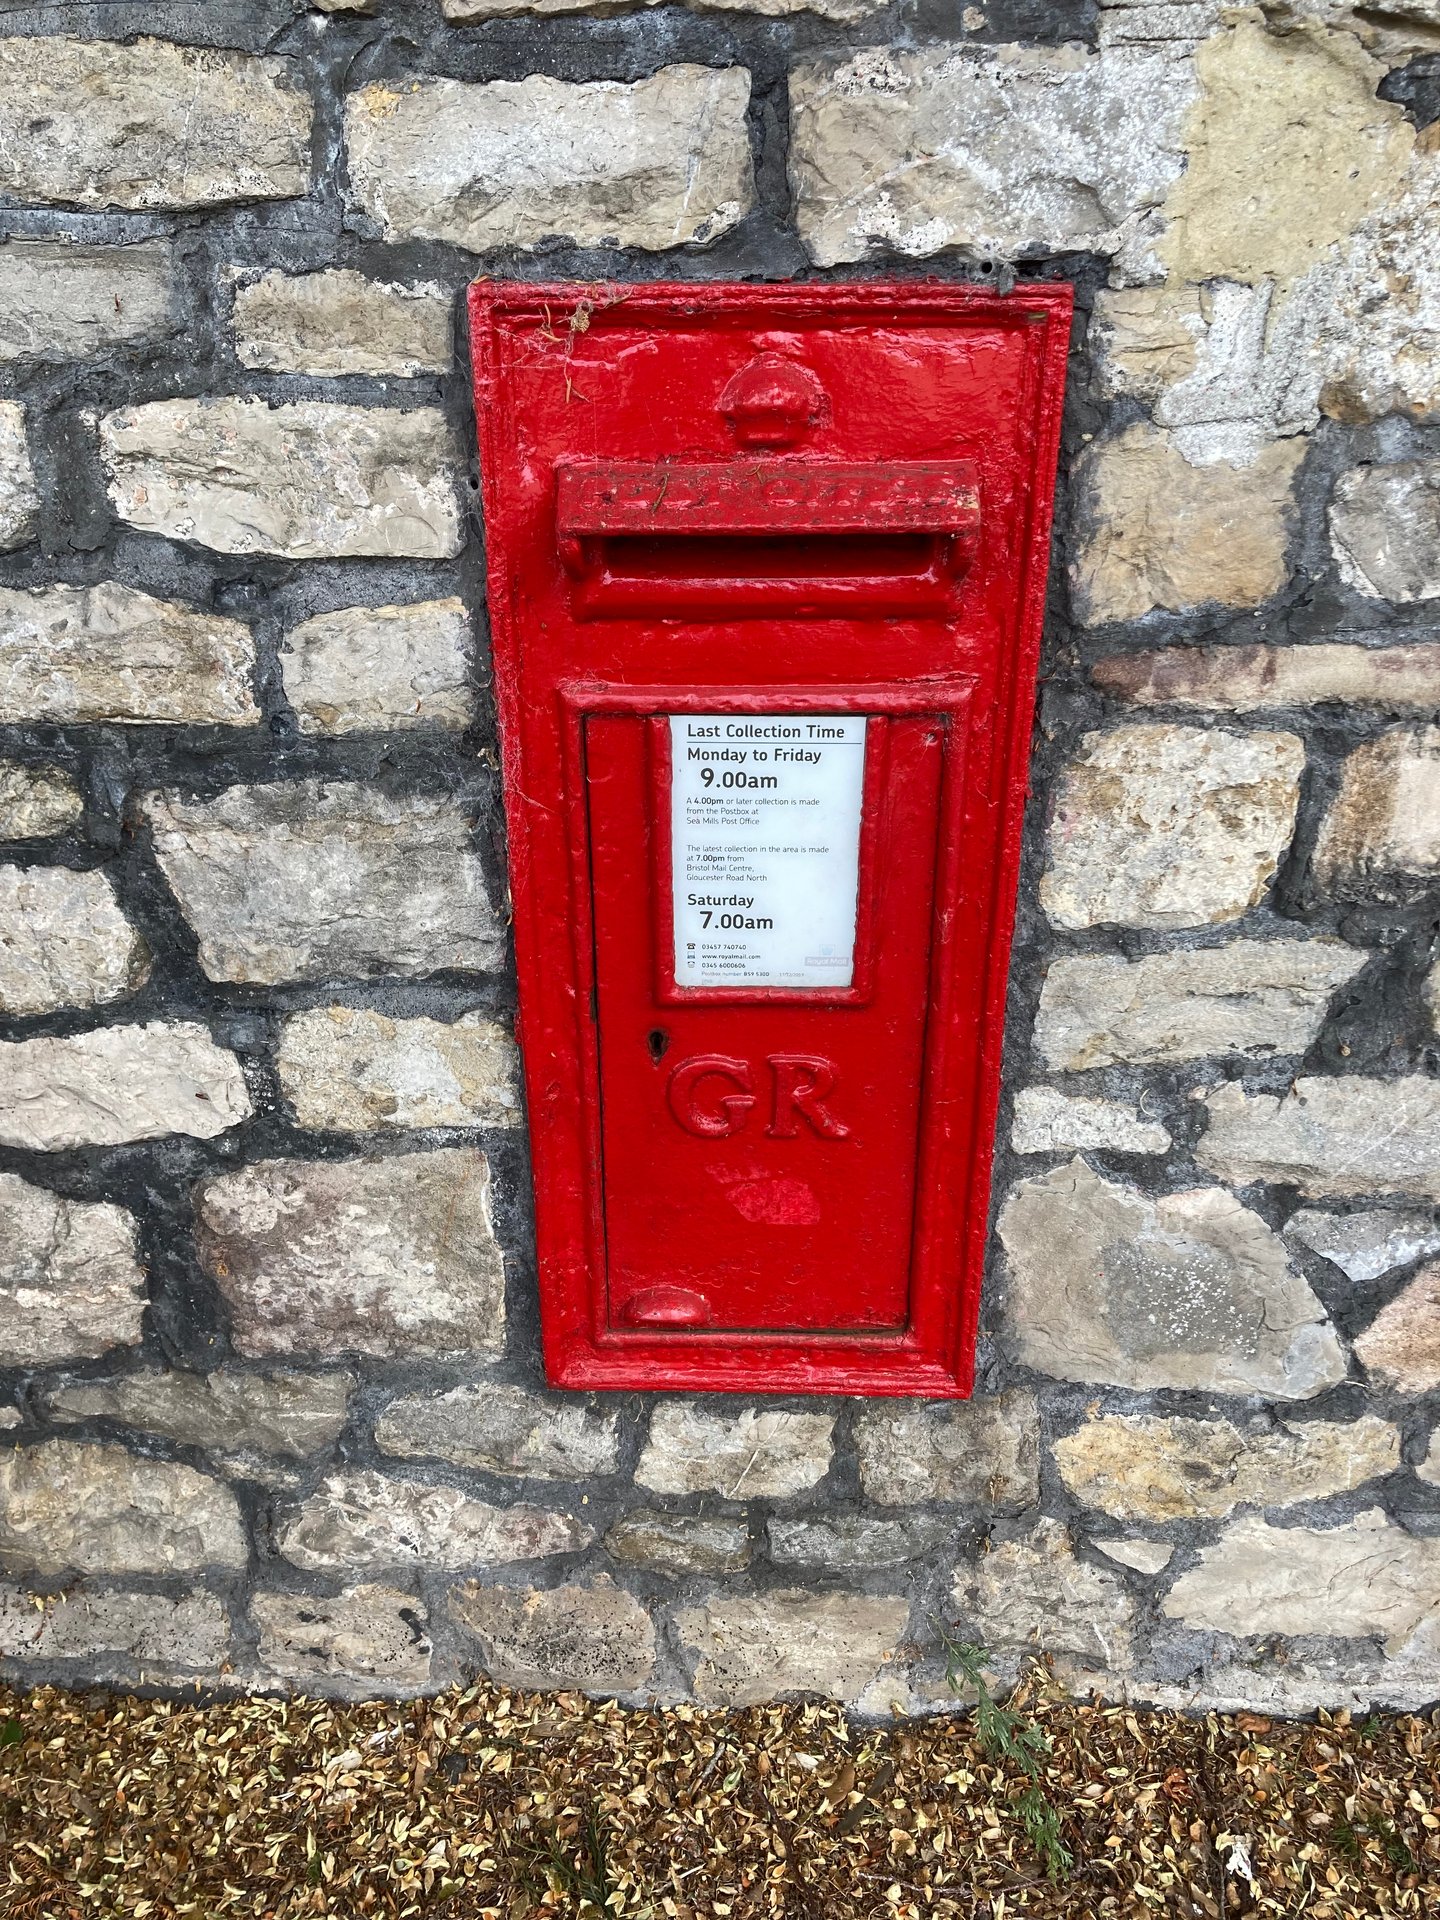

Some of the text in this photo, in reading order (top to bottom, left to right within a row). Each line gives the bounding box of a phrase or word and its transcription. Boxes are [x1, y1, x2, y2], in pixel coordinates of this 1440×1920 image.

[687, 724, 845, 739] Last Collection Time
[687, 747, 821, 764] Monday to Friday
[700, 767, 778, 789] 9.00am
[686, 797, 693, 805] A
[694, 797, 724, 807] 4.00pm
[736, 797, 752, 805] later
[755, 797, 789, 806] collection
[791, 798, 797, 806] is
[799, 798, 820, 806] made
[686, 807, 704, 815] from
[706, 807, 718, 815] the
[721, 807, 749, 815] Postbox
[686, 817, 760, 825] Sea Mills Post Office
[687, 845, 700, 853] The
[702, 845, 722, 853] latest
[724, 845, 758, 853] collection
[760, 845, 767, 853] in
[768, 845, 781, 853] the
[801, 846, 806, 854] is
[808, 846, 829, 854] made
[695, 854, 725, 864] 7.00pm
[686, 864, 755, 873] Bristol Mail Centre,
[746, 874, 768, 882] North
[687, 893, 755, 908] Saturday
[699, 910, 773, 929] 7.00am
[666, 1053, 850, 1140] GR
